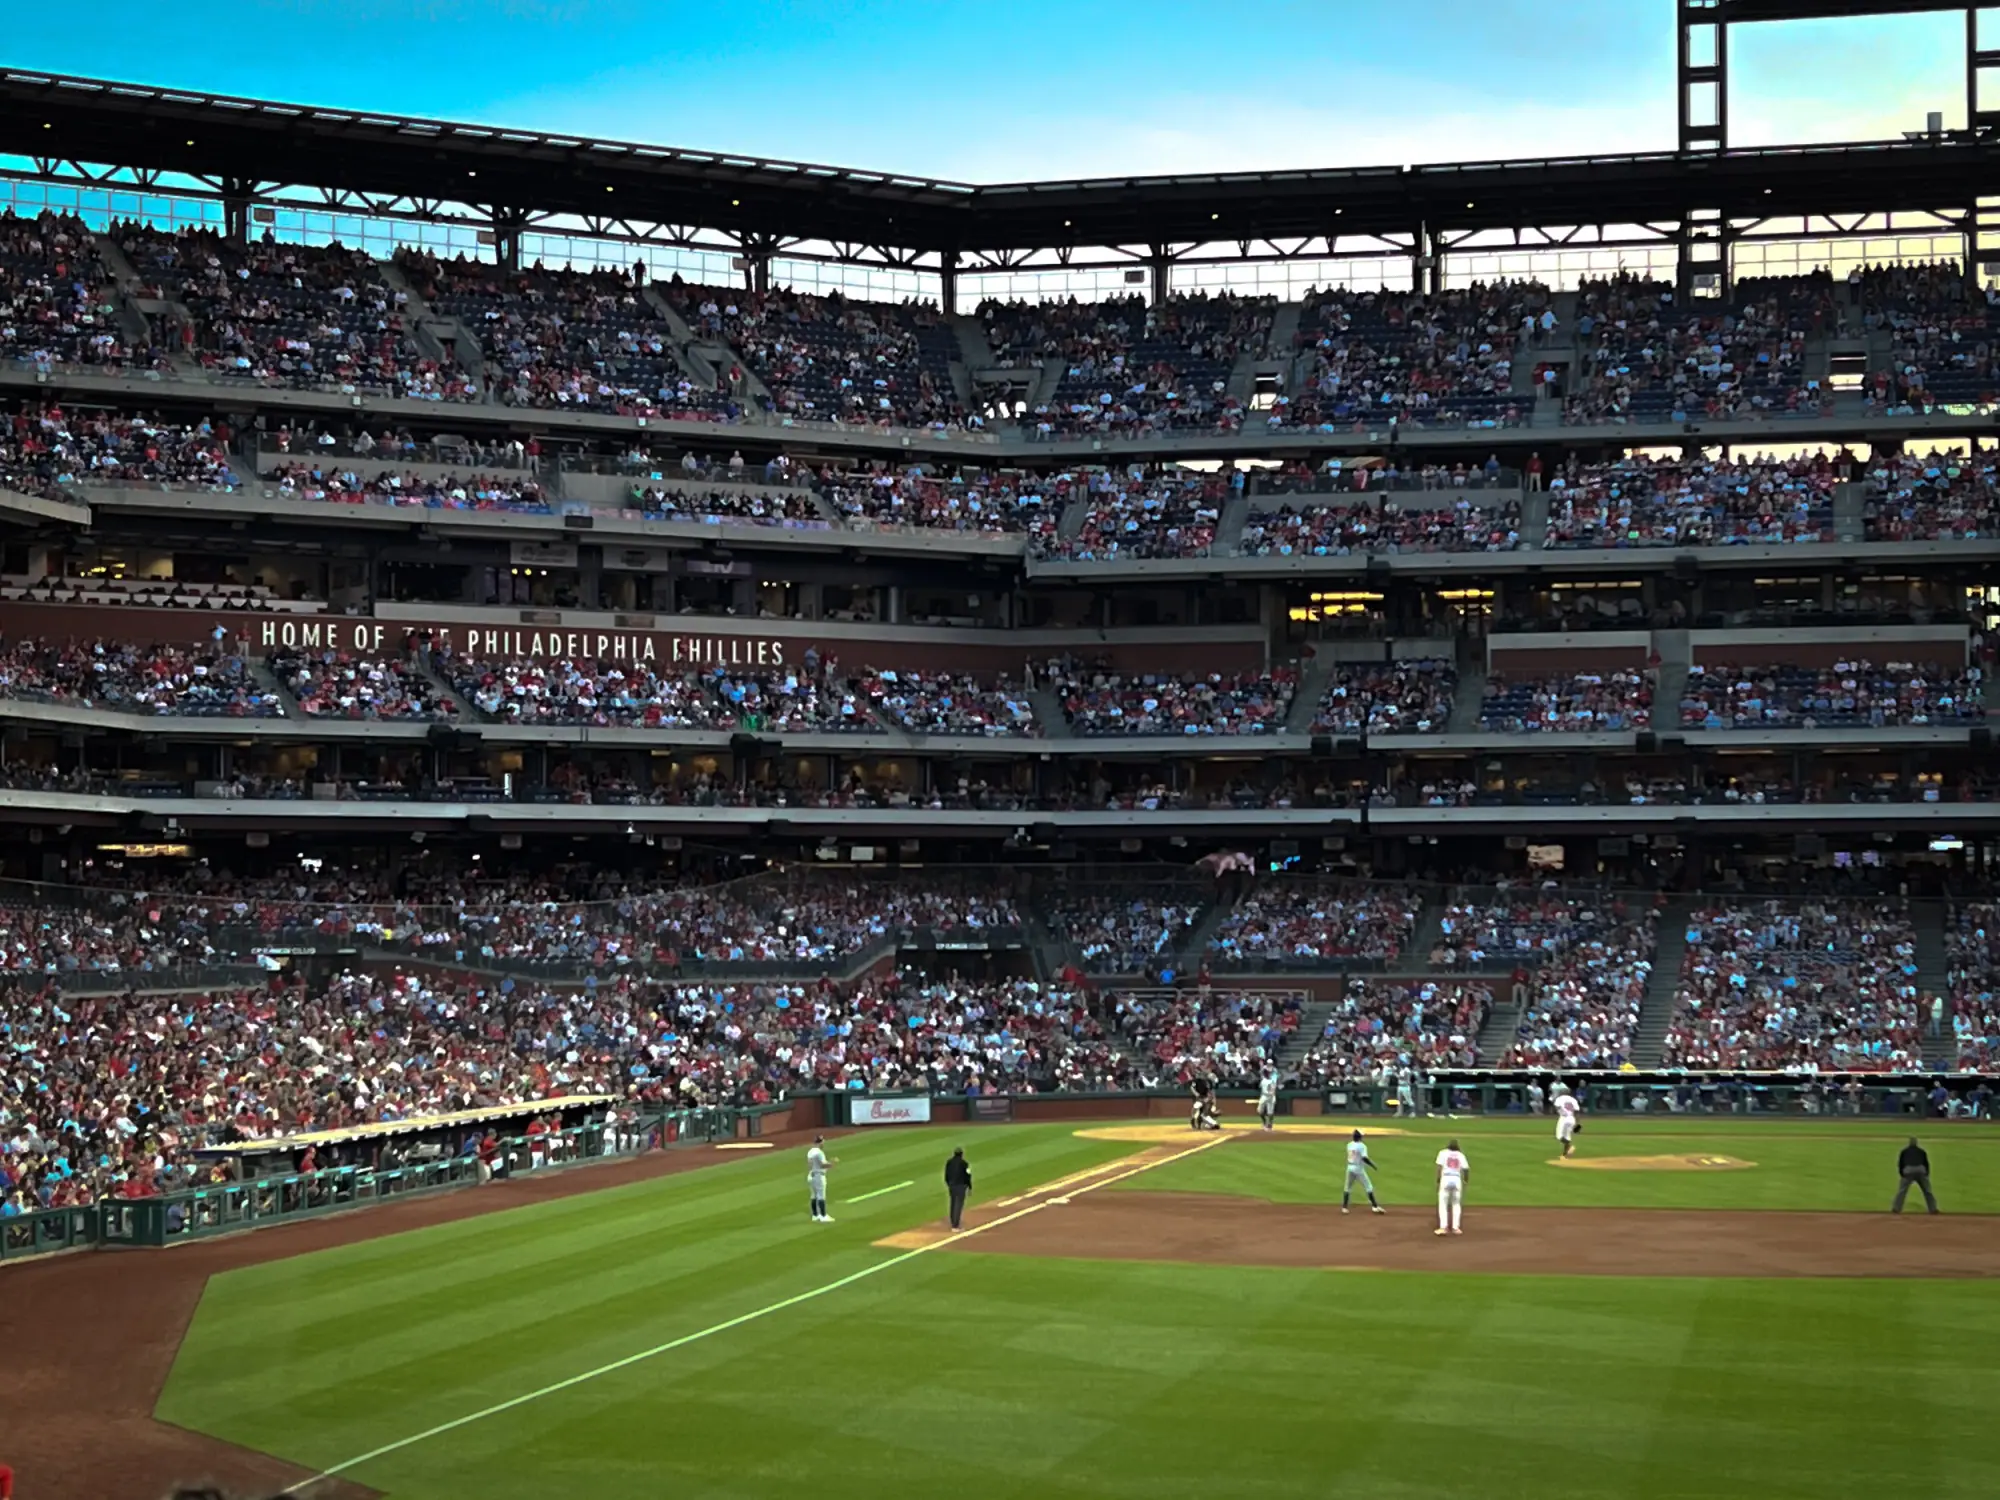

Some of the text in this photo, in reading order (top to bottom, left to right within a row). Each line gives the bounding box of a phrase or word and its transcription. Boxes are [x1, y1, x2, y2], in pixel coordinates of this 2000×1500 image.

[262, 621, 338, 648] HOME
[354, 624, 385, 650] OF
[467, 629, 656, 660] PHILADELPHIA
